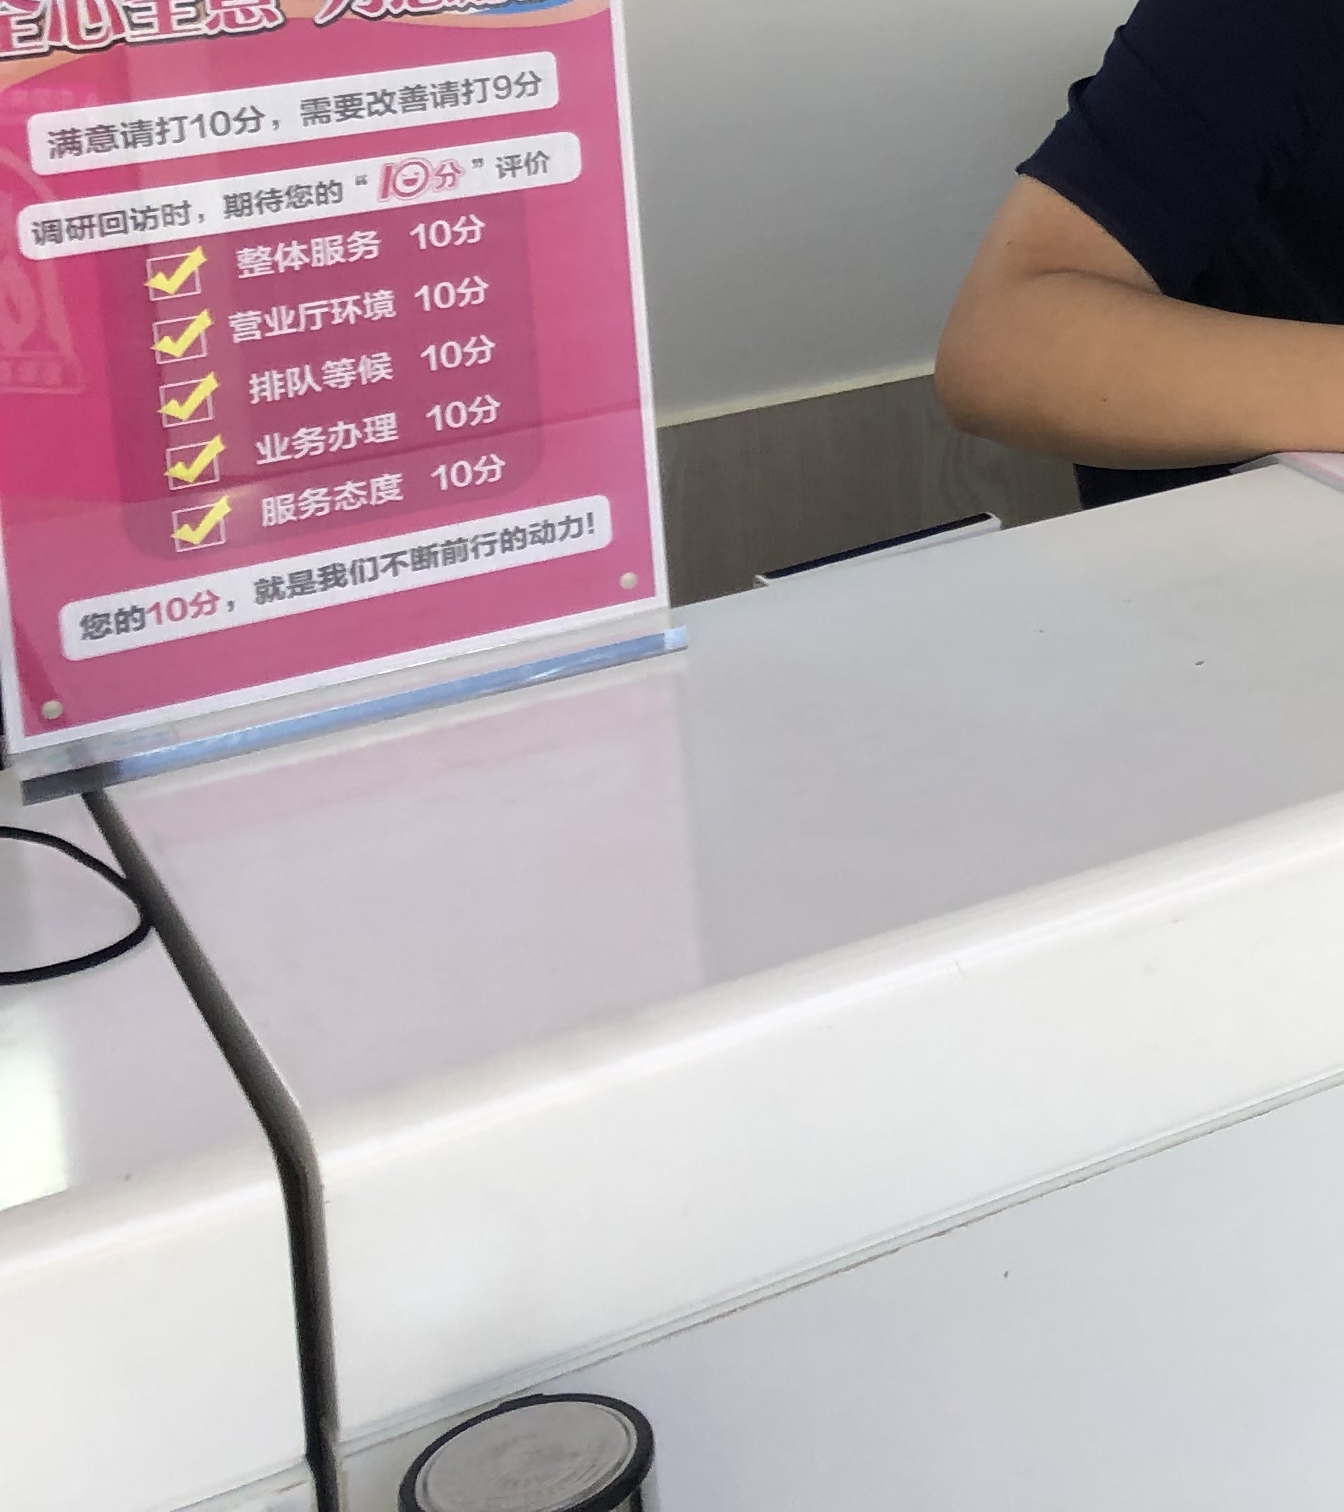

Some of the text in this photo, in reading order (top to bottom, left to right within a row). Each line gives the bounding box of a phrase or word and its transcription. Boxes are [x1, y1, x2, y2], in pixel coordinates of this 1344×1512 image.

[47, 70, 544, 159] 满意请打10分，需要改善请打9分
[236, 214, 486, 279] 整体服务 10分
[228, 275, 489, 344] 营业厅环境 10分
[249, 335, 496, 405] 排队等候 10分
[255, 394, 501, 466] 业务办理 10分
[262, 453, 506, 528] 服务态度 10分
